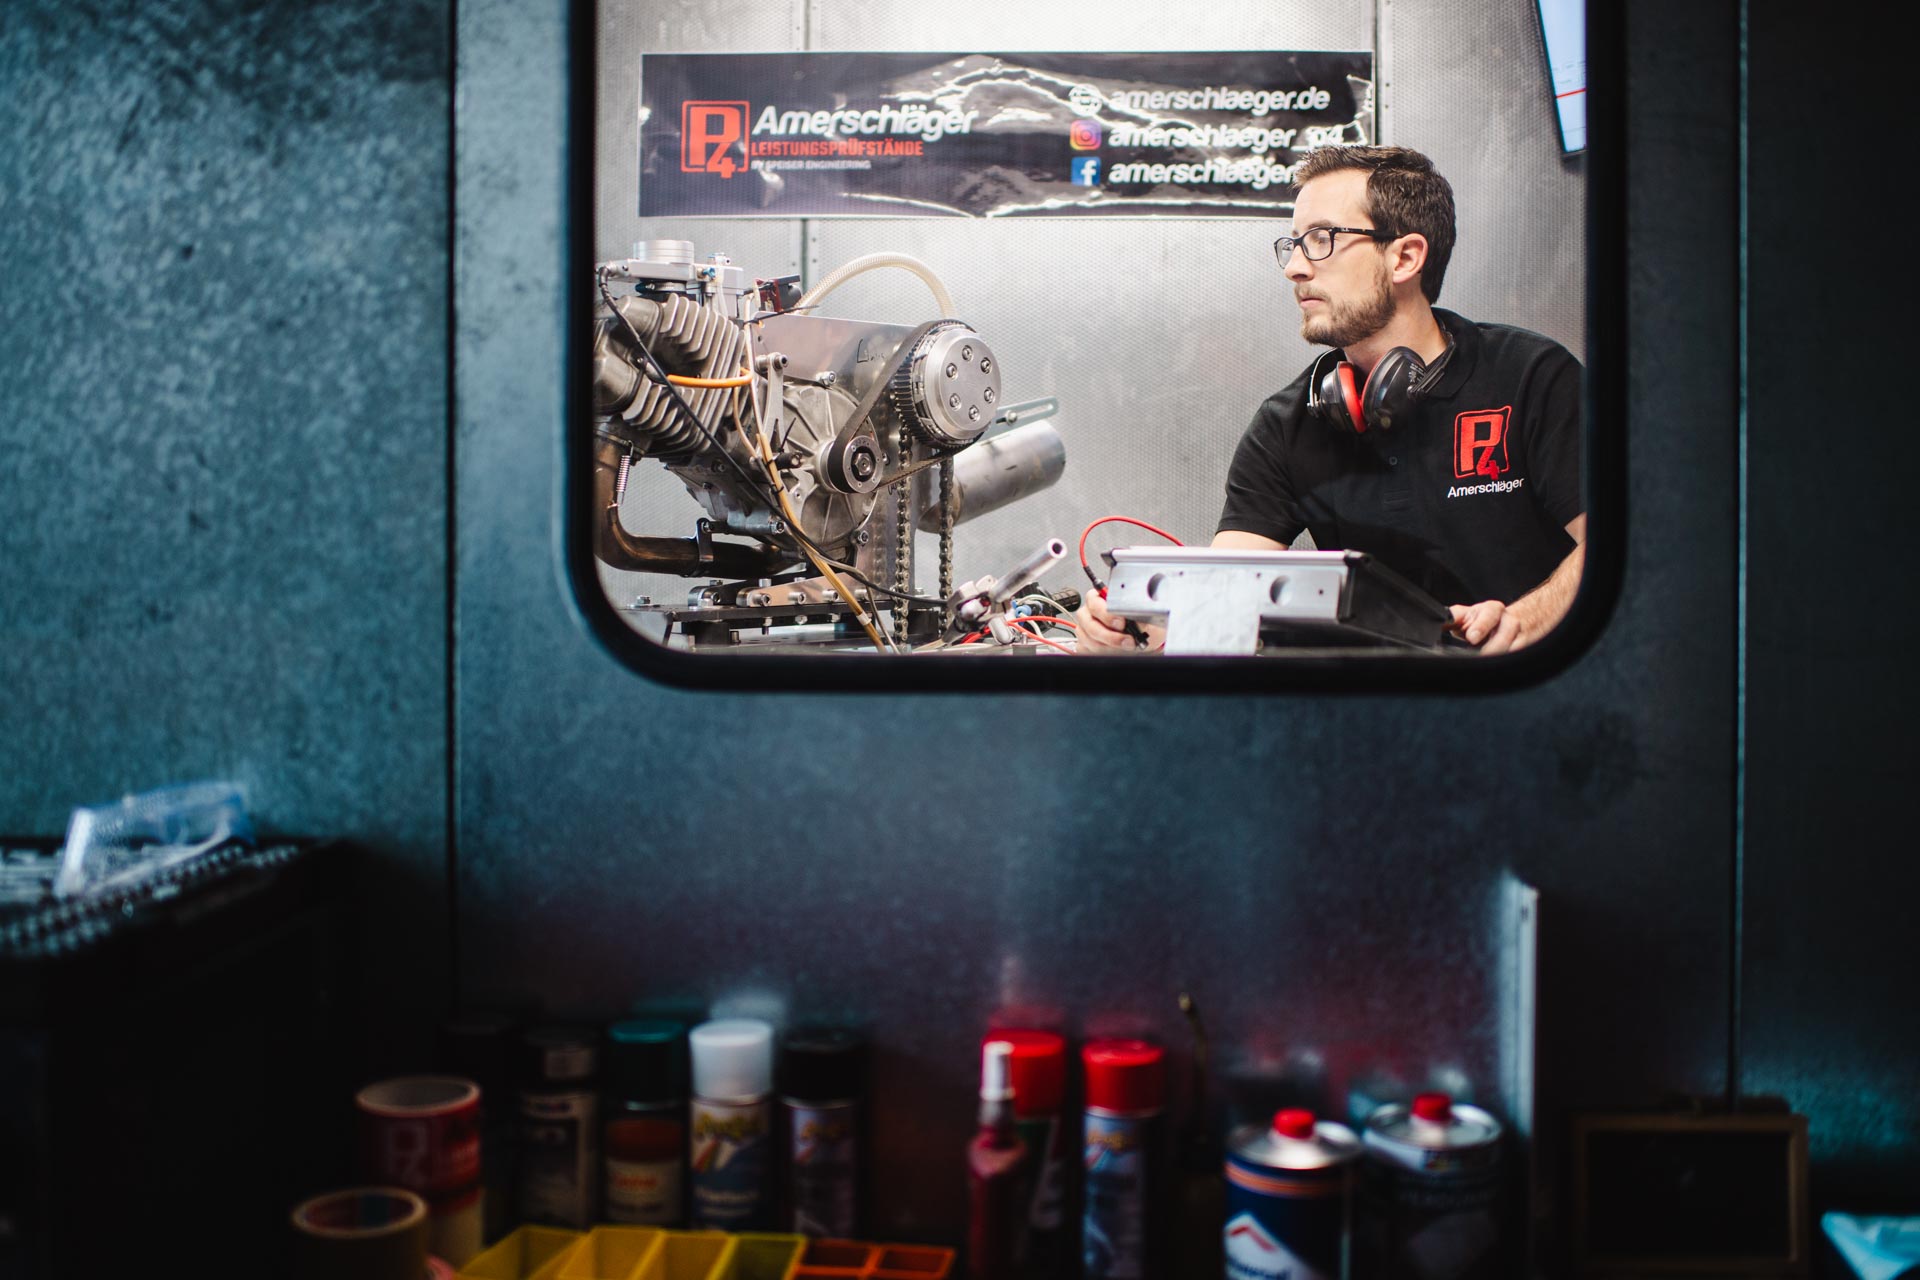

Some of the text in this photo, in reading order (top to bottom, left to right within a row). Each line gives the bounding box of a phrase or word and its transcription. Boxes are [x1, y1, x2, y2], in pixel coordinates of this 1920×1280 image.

[1109, 86, 1330, 116] amerschlaeger.de
[752, 105, 979, 142] Amerschläger
[751, 138, 924, 156] LEISTUNGSPRÜFSTÄNDE
[805, 160, 871, 169] ENGINEERING
[1447, 477, 1525, 498] Amerschläger
